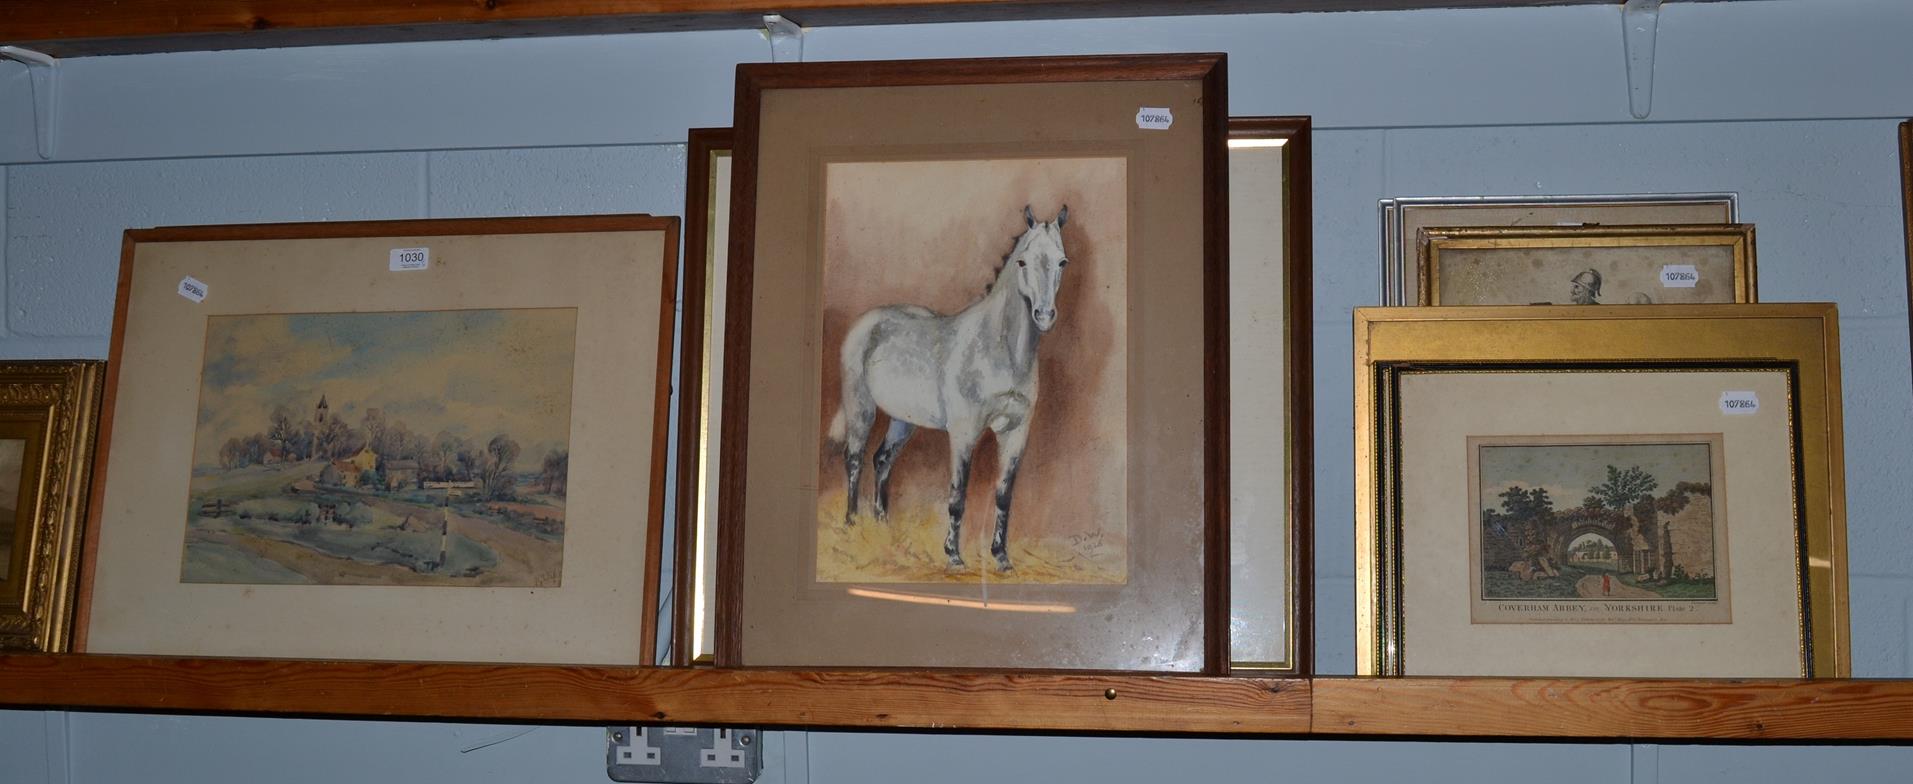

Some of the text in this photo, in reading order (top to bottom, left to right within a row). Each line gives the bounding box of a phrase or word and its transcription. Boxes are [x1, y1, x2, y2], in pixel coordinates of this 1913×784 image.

[1141, 114, 1169, 123] 107864
[400, 252, 424, 262] 1030
[1666, 272, 1695, 281] 107864
[1725, 400, 1755, 409] 107864
[1498, 603, 1550, 612] COVERHAM
